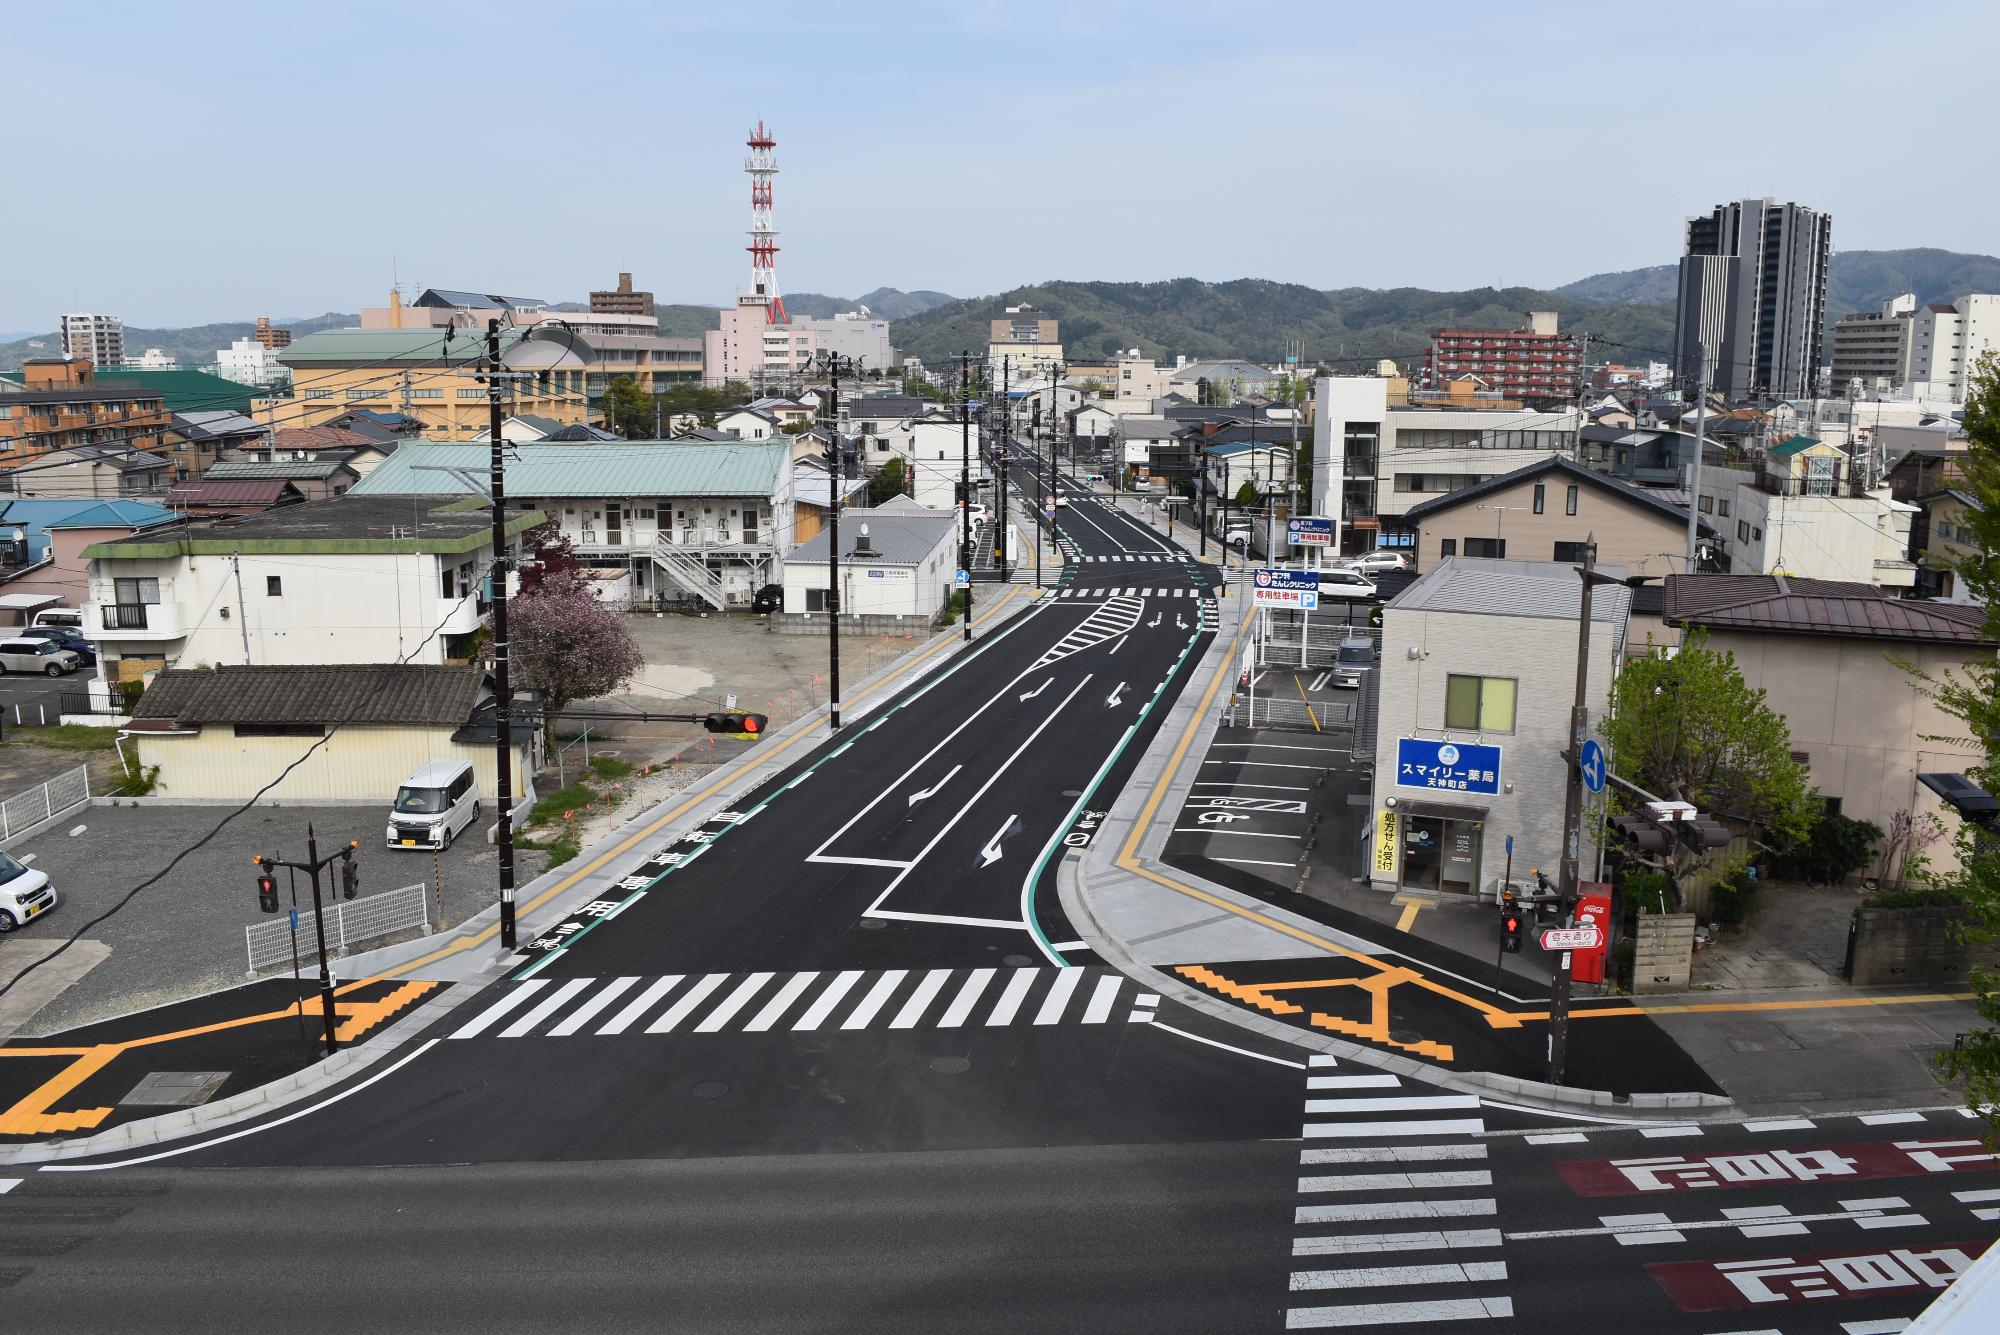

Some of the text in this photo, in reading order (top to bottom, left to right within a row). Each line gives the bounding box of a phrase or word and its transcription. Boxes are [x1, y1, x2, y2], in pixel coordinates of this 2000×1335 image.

[1271, 580, 1316, 589] たんじクリニック
[1256, 590, 1299, 601] 専用駐車場
[1303, 593, 1315, 607] P
[1402, 763, 1494, 783] スマイリー薬局
[1427, 777, 1468, 790] 天神町店
[1382, 812, 1396, 871] 処方せん受付
[1552, 931, 1592, 942] 信夫通り
